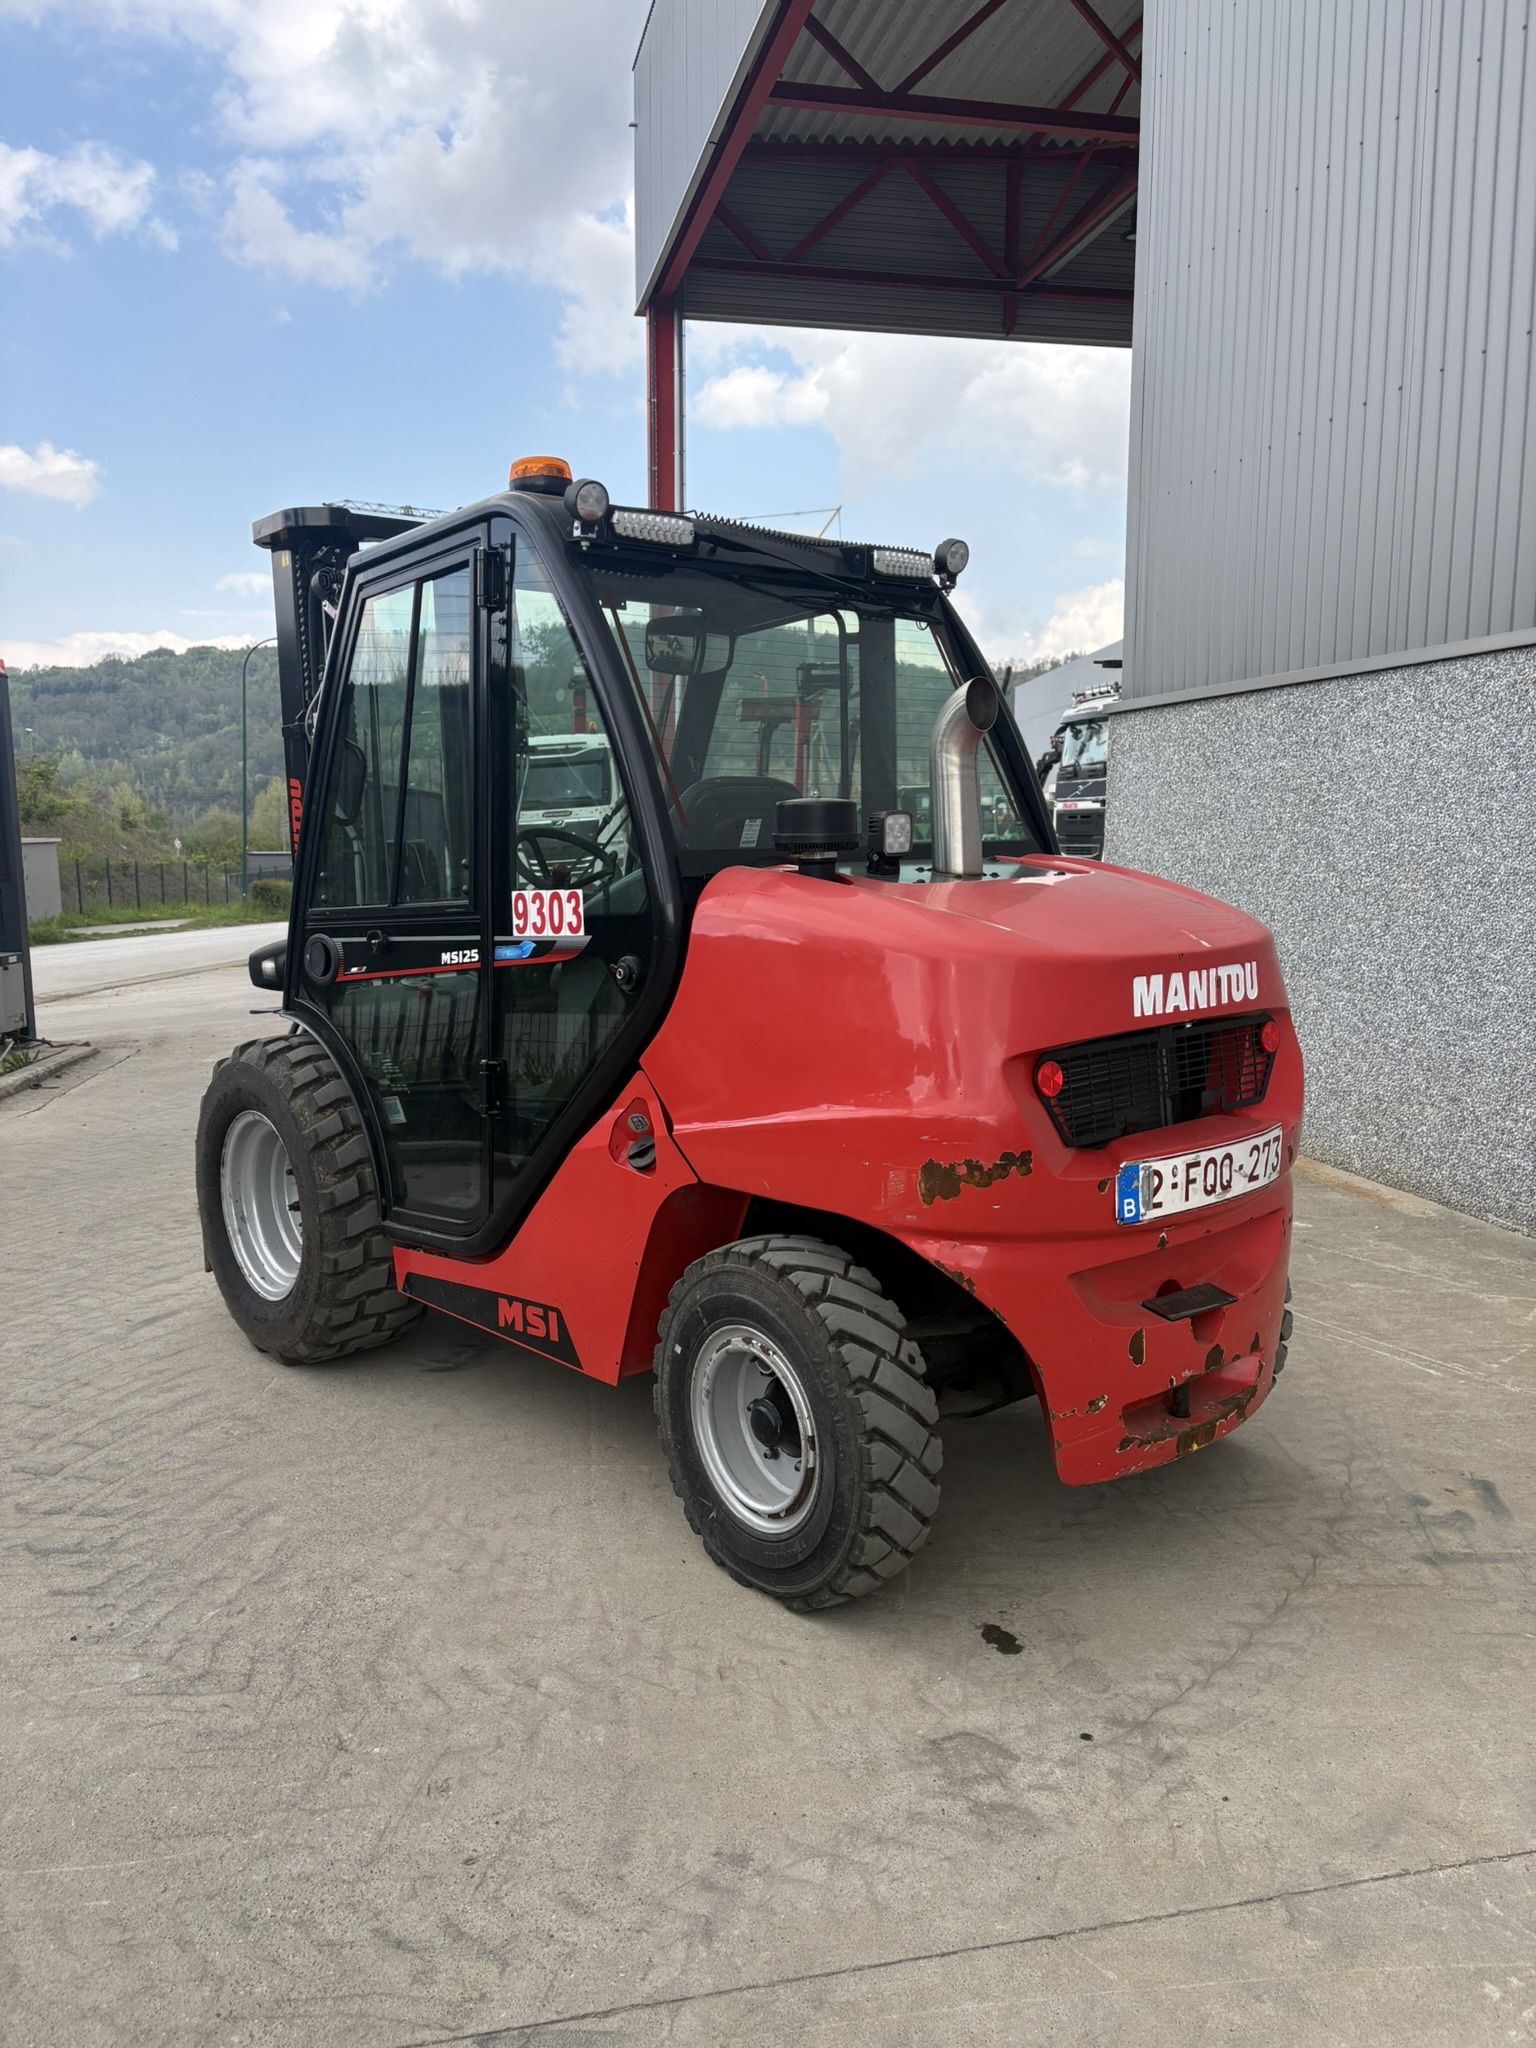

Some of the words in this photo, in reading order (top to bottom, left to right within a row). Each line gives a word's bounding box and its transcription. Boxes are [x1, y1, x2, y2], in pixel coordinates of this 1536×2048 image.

[513, 890, 583, 935] 9303
[441, 948, 480, 965] MSI25
[1132, 960, 1259, 1018] MANITOU
[1123, 1198, 1137, 1218] B
[497, 1296, 560, 1343] MSI
